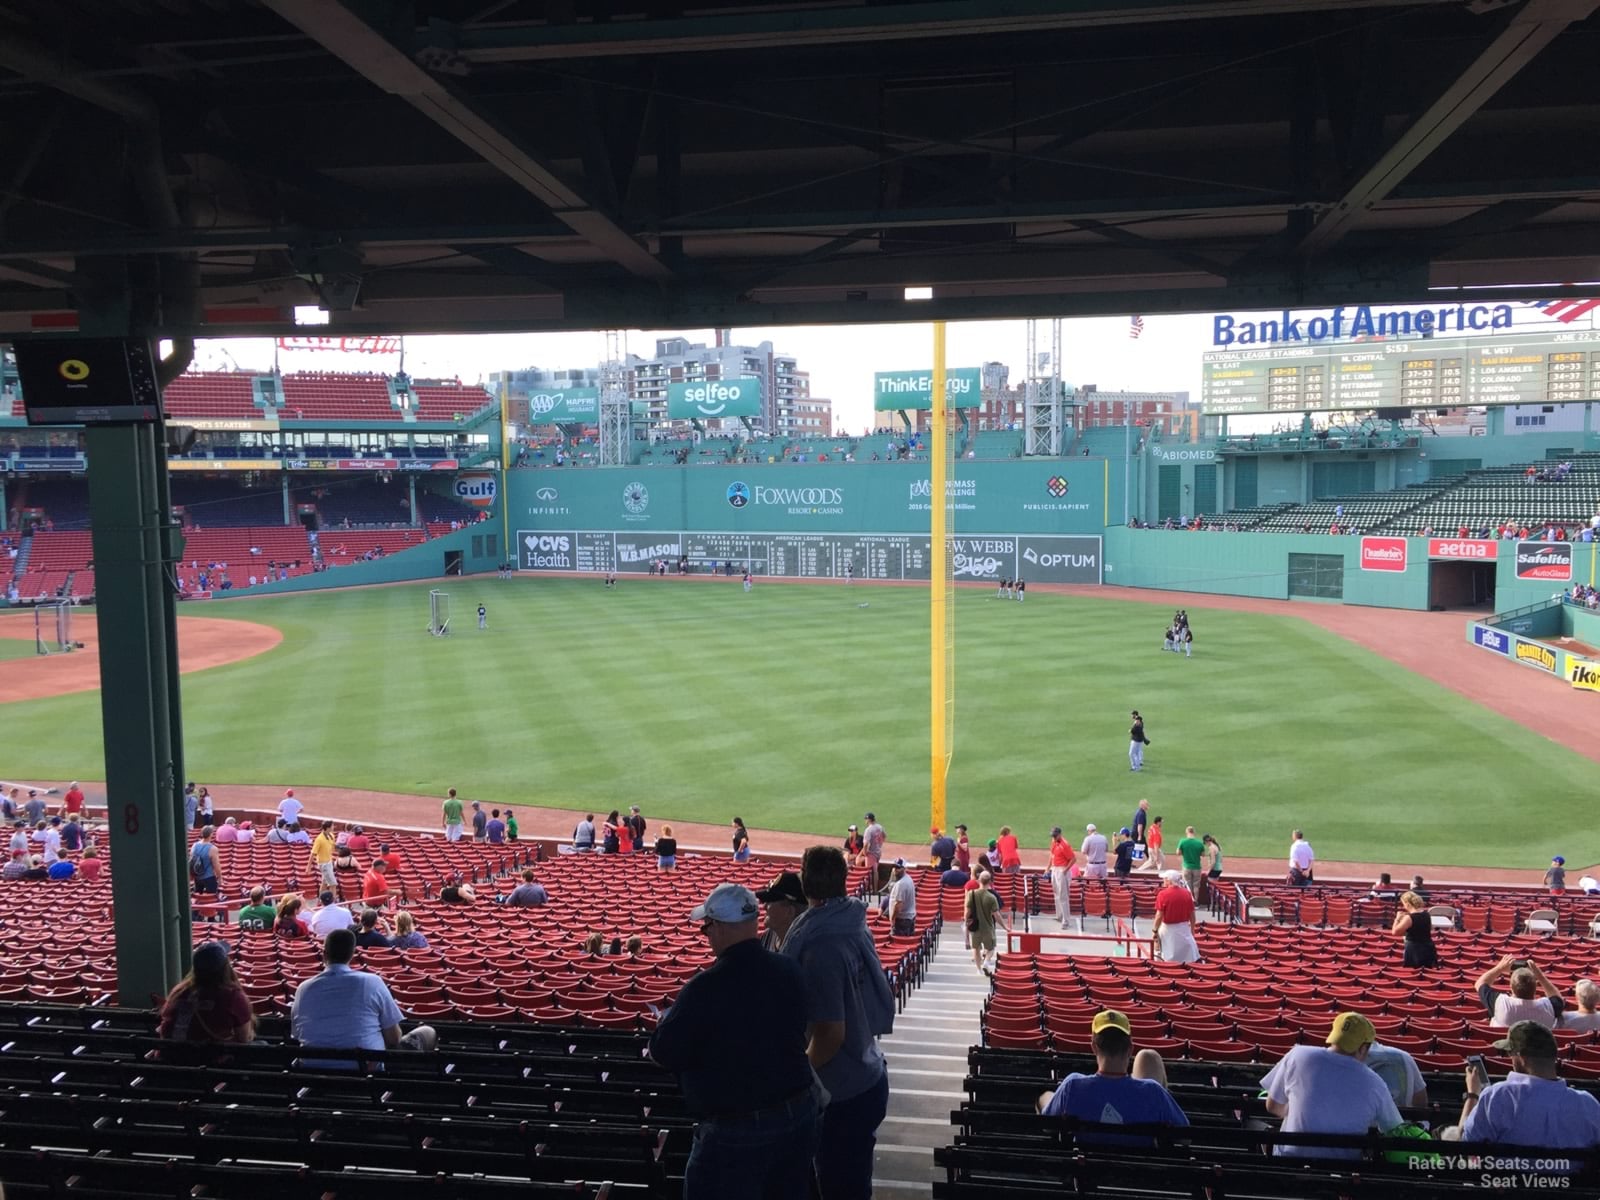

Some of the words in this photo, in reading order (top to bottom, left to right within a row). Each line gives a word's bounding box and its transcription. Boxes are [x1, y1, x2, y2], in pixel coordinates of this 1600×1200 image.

[1213, 309, 1302, 346] Bank
[1308, 306, 1345, 340] of
[1351, 303, 1512, 337] America
[1204, 352, 1240, 360] NATIONAL
[1243, 352, 1271, 360] LEAGUE
[1274, 349, 1314, 358] STANDINGS
[1386, 344, 1408, 353] 5:53
[1162, 450, 1215, 460] ABIOMED
[456, 482, 494, 496] Gulf
[754, 486, 843, 505] FOXWOODS
[528, 507, 570, 515] INFINITI
[539, 536, 570, 552] CVS
[970, 540, 1014, 553] WEBB
[1439, 542, 1486, 556] aetna
[527, 552, 570, 568] Health
[1040, 554, 1095, 567] OPTUM
[1518, 554, 1570, 565] Safelite
[1532, 568, 1570, 578] AutoGlass
[124, 804, 139, 834] 8
